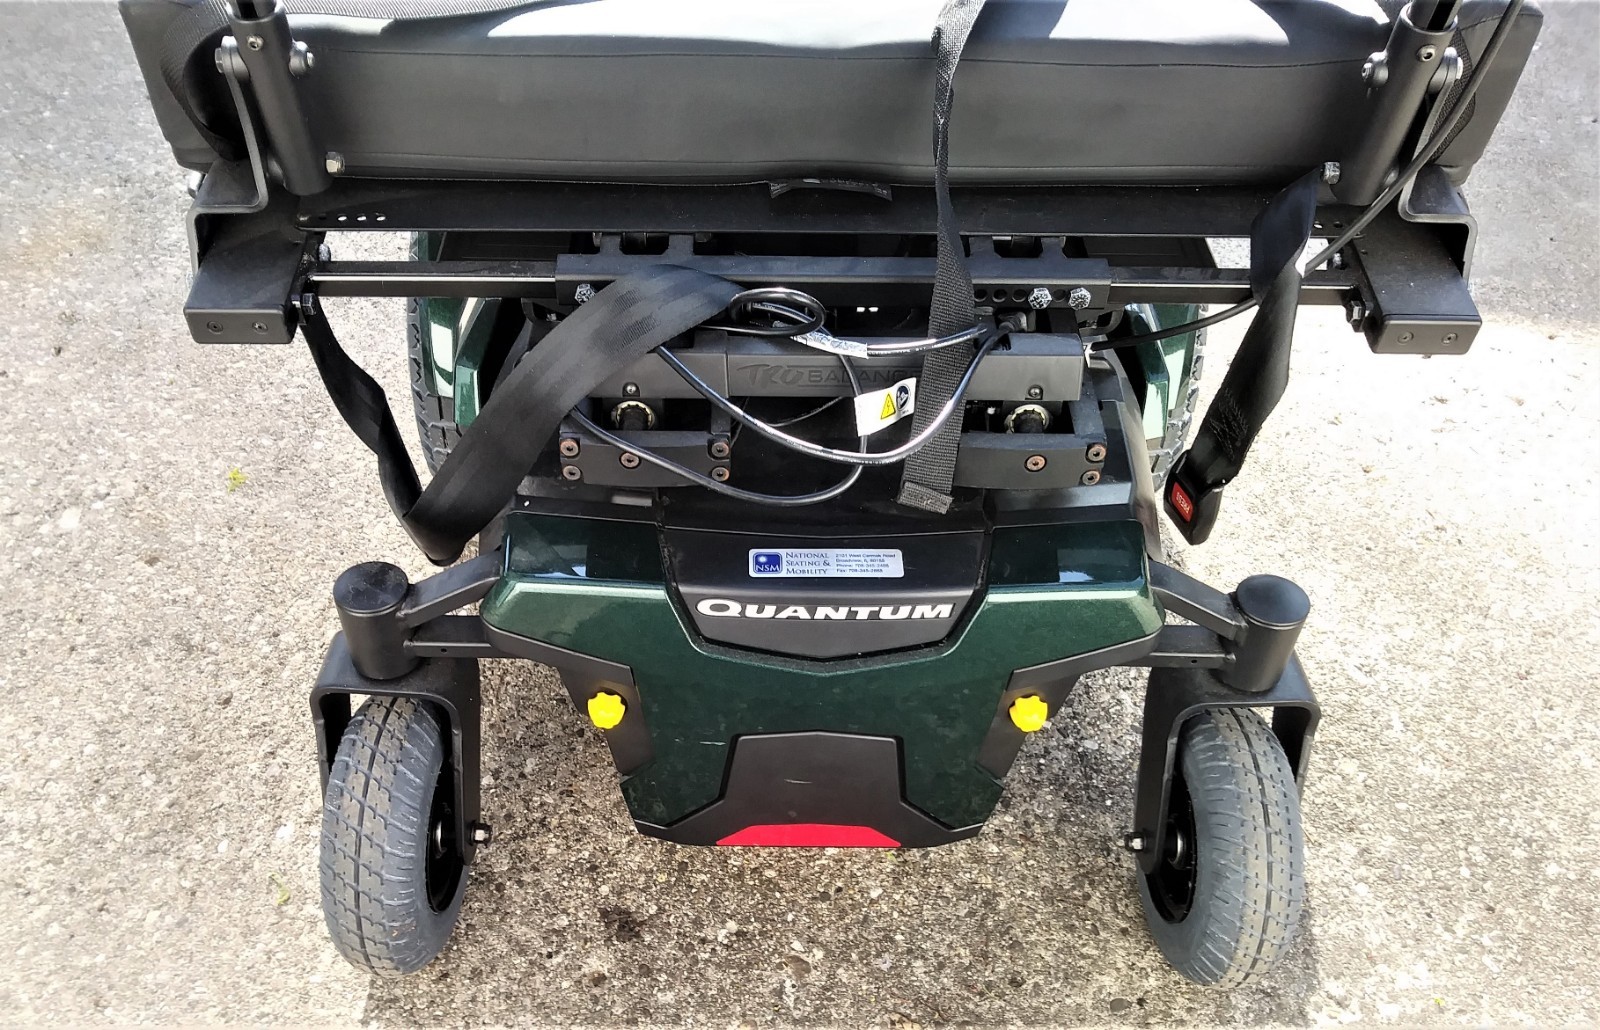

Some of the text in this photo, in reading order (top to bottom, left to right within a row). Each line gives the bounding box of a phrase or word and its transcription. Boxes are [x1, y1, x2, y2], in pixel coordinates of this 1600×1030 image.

[755, 564, 780, 572] NSM
[786, 567, 828, 575] MOBILITY
[696, 598, 954, 620] QUANTUM
